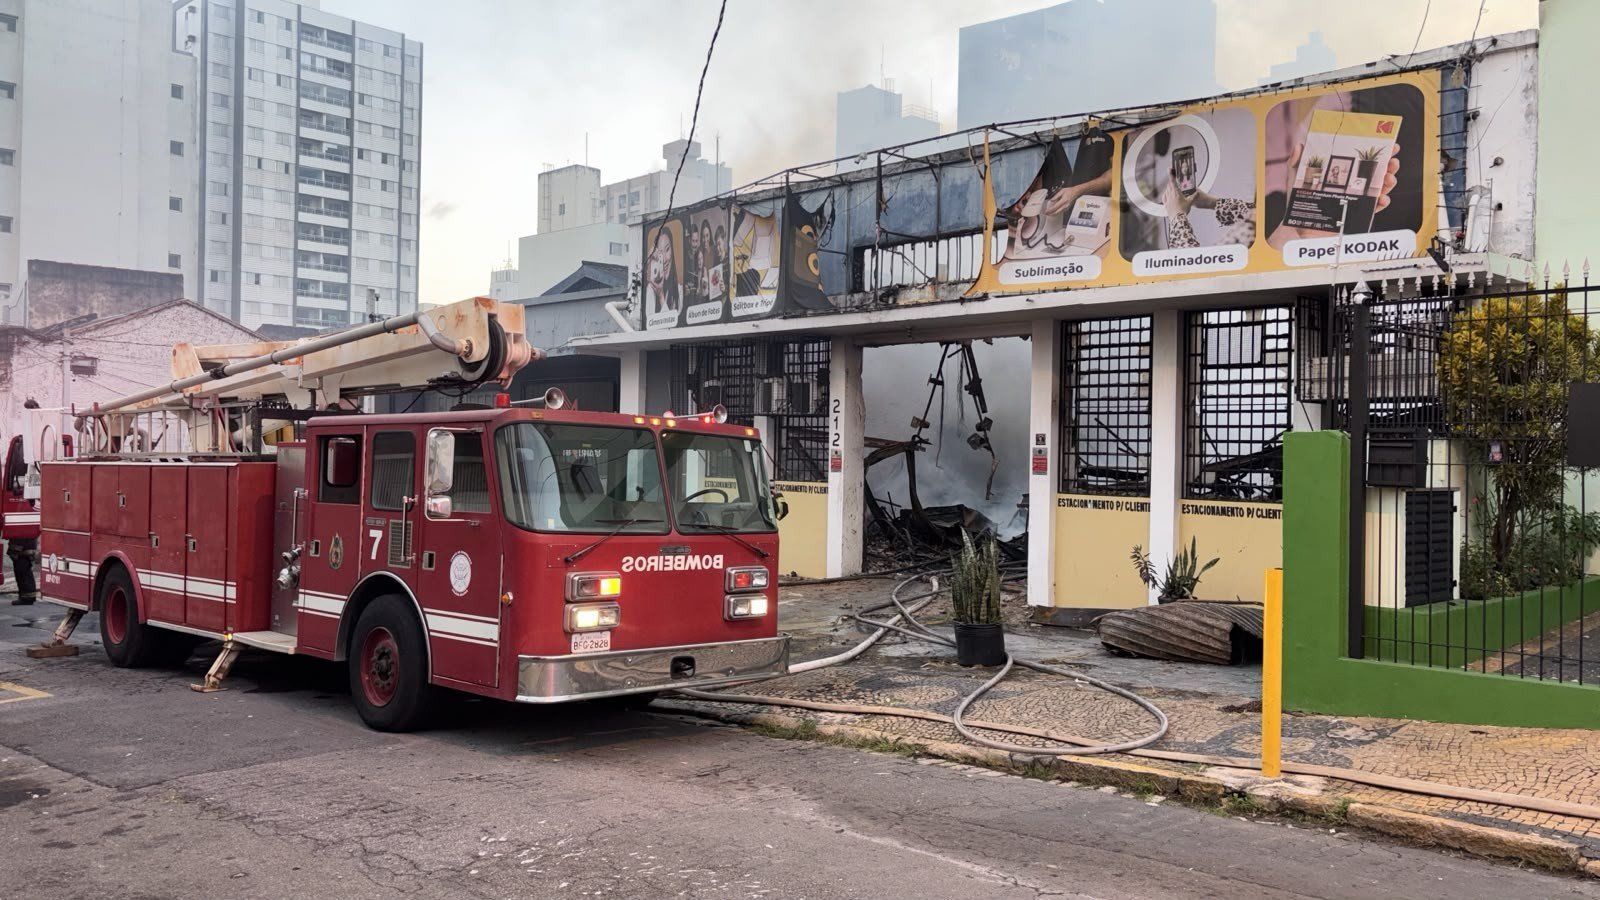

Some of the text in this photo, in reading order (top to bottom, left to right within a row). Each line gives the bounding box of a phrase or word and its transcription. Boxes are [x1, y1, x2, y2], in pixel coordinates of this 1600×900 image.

[1299, 240, 1400, 259] Pape KODAK
[1145, 252, 1235, 269] Iluminadores
[1015, 262, 1083, 278] Sublimação
[832, 399, 841, 447] 212
[775, 484, 808, 494] STACIONAMENTO
[1116, 501, 1124, 512] P/
[1182, 504, 1244, 518] ESTACIONAMENTO
[1247, 507, 1255, 518] P/
[369, 529, 383, 560] 7
